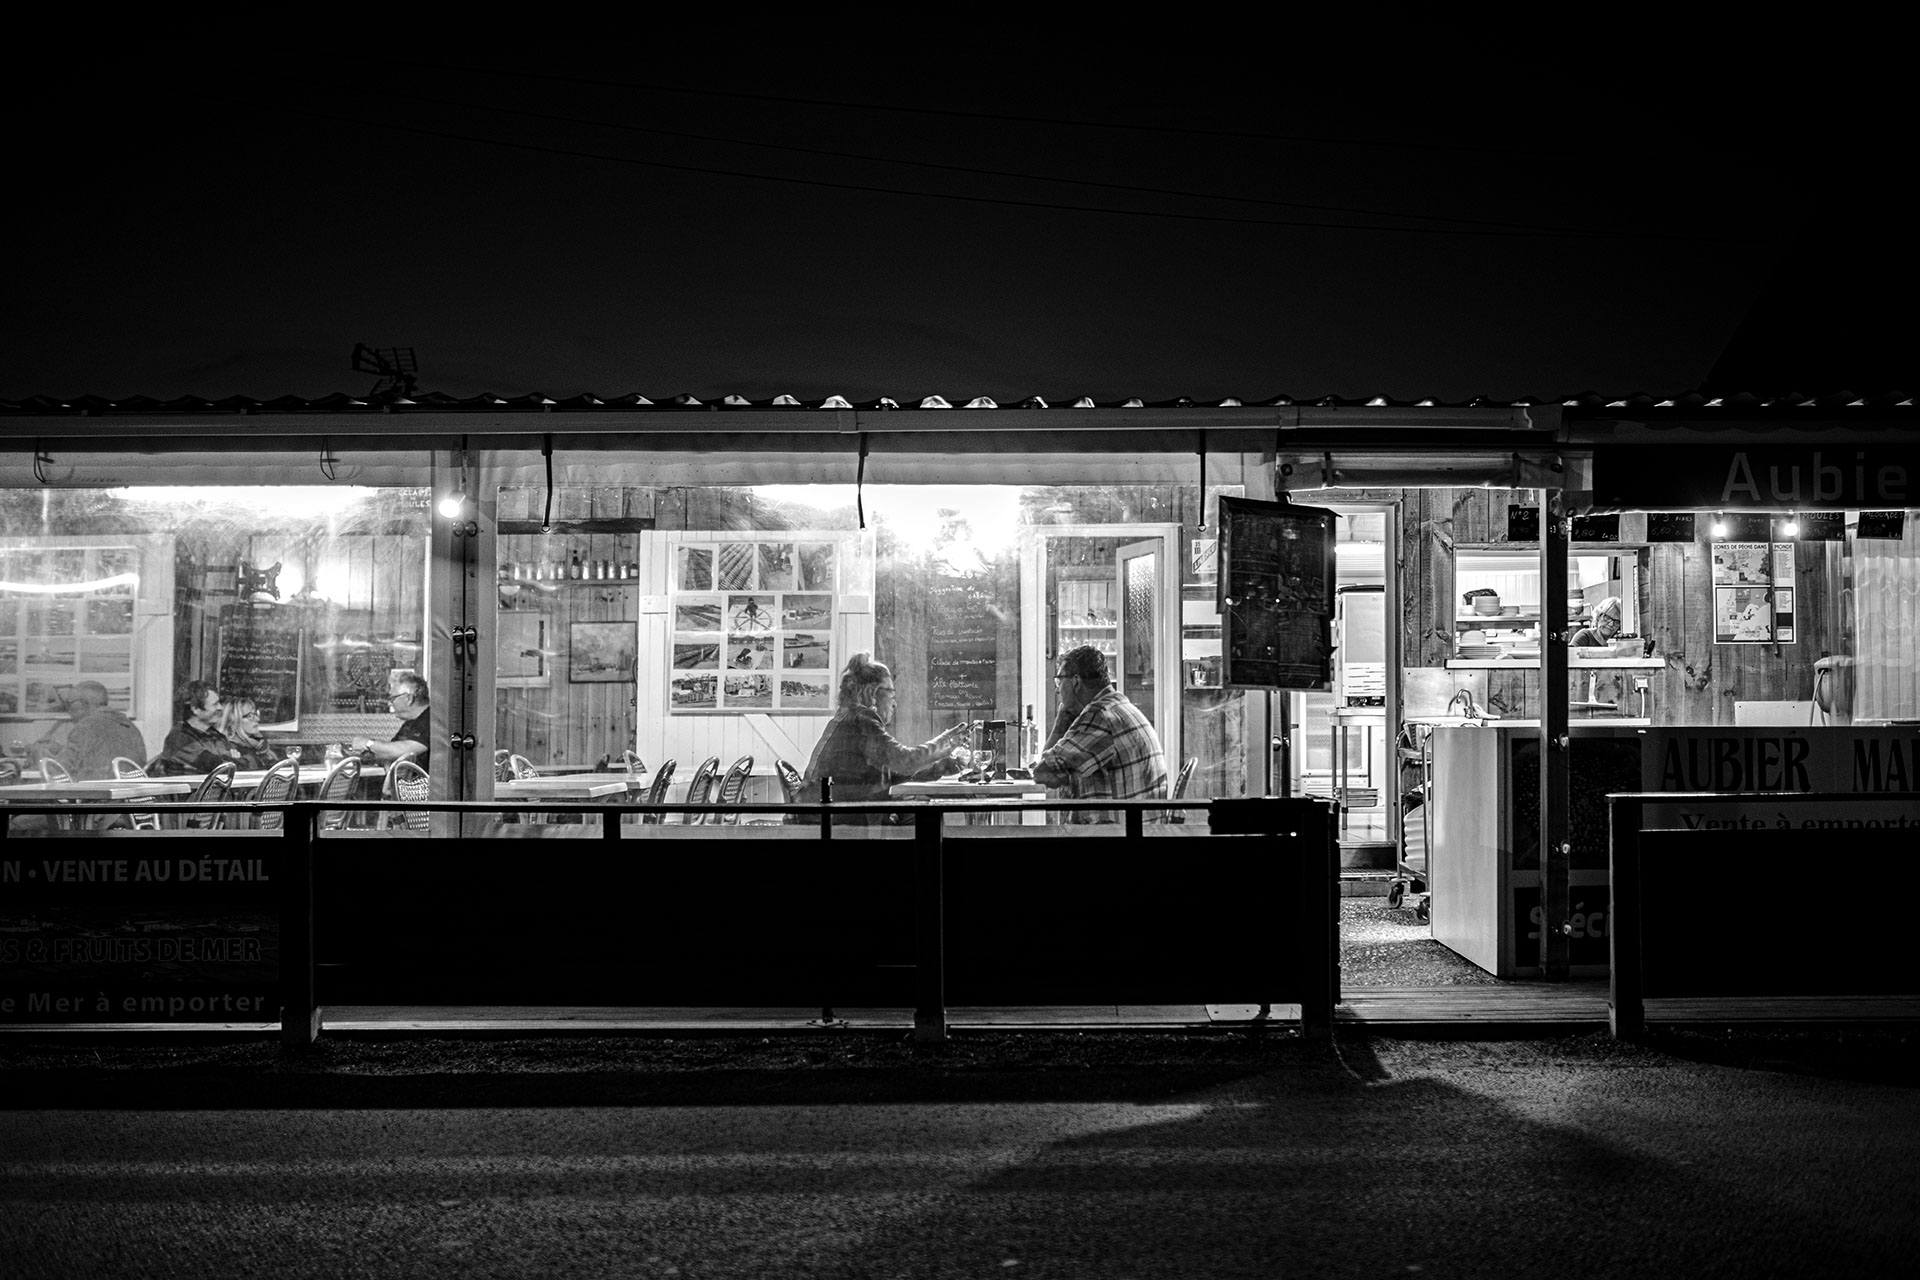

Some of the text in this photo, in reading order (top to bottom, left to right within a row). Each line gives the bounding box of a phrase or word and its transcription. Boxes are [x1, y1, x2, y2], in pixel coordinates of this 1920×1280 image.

[1721, 451, 1907, 502] Aubie
[1660, 737, 1811, 792] AUBIER
[0, 854, 270, 883] N VENTE AU DÉTAIL
[26, 938, 48, 963] &
[54, 938, 152, 963] FRUITS
[158, 938, 196, 963] DE
[202, 938, 262, 963] MER
[27, 992, 85, 1014] Mer
[96, 990, 111, 1014] à
[122, 992, 265, 1018] emporter
